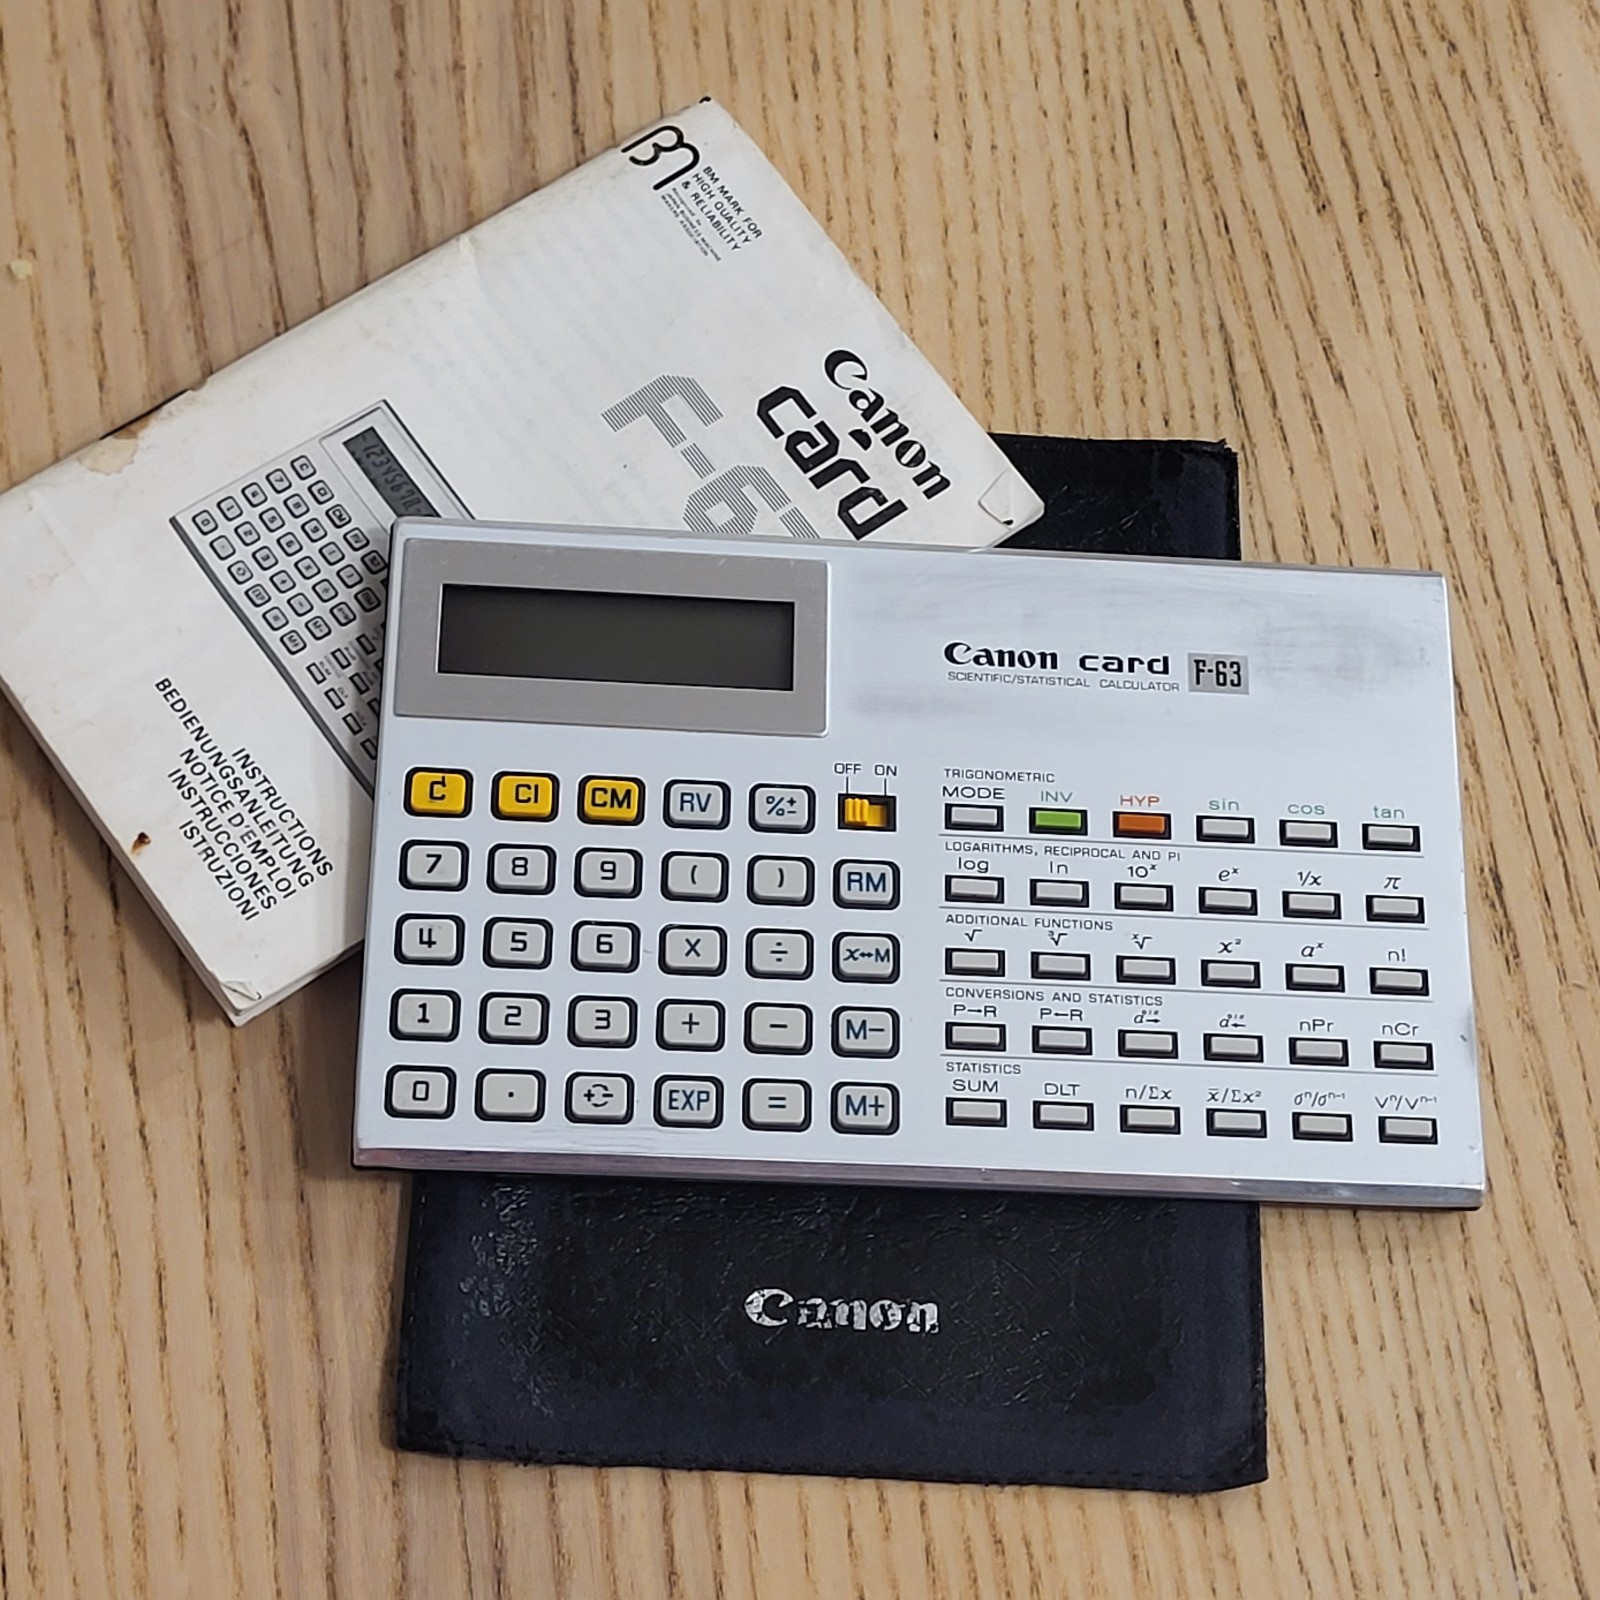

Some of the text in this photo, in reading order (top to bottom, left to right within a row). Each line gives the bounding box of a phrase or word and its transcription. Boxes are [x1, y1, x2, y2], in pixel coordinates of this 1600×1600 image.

[692, 172, 752, 245] HIGH QUALITY
[702, 166, 763, 239] BM MARK FOR
[682, 181, 742, 252] & RELIABILITY
[823, 349, 951, 501] Canon
[756, 385, 909, 541] card
[943, 642, 1242, 688] Canon card F-63
[947, 671, 1180, 692] SCIENTIFIC/STATISTICAL CALCULATOR
[834, 763, 862, 775] OFF
[874, 764, 897, 777] ON
[944, 768, 1055, 783] TRIGONOMETRIC
[154, 678, 315, 888] BEDIENUNGSANLEITUNG
[942, 786, 1005, 800] MODE
[591, 787, 632, 809] CM
[680, 792, 712, 813] RV
[1040, 790, 1073, 803] INV
[1120, 795, 1160, 807] HYP
[1208, 798, 1240, 812] sin
[232, 747, 334, 877] INSTRUCTIONS
[1287, 803, 1325, 815] cos
[1373, 806, 1405, 819] tan
[179, 748, 297, 899] NOTICE D'EMPLOI
[168, 768, 277, 910] INSTRUCCIONES
[945, 841, 1180, 862] LOGARITHMS, RECIPROCAL AND PI
[179, 820, 260, 921] ISTRUZIONI
[426, 854, 442, 874] 7
[511, 857, 529, 876] 8
[600, 861, 617, 880] 9
[958, 857, 989, 874] log
[847, 871, 886, 892] RM
[945, 914, 1113, 931] ADDITIONAL FUNCTIONS
[419, 928, 437, 948] 4
[510, 931, 528, 952] 5
[596, 934, 613, 954] 6
[945, 987, 1163, 1006] CONVERSIONS AND STATISTICS
[417, 1003, 430, 1023] 1
[504, 1005, 522, 1026] 2
[594, 1009, 611, 1030] 3
[1299, 1019, 1334, 1033] nPr
[1381, 1023, 1419, 1036] nCr
[946, 1061, 1021, 1075] STATISTICS
[412, 1080, 429, 1101] 0
[952, 1079, 999, 1093] SUM
[1044, 1083, 1081, 1096] DLT
[668, 1090, 710, 1111] EXP
[845, 1095, 885, 1116] M+
[744, 1288, 939, 1333] Canon
